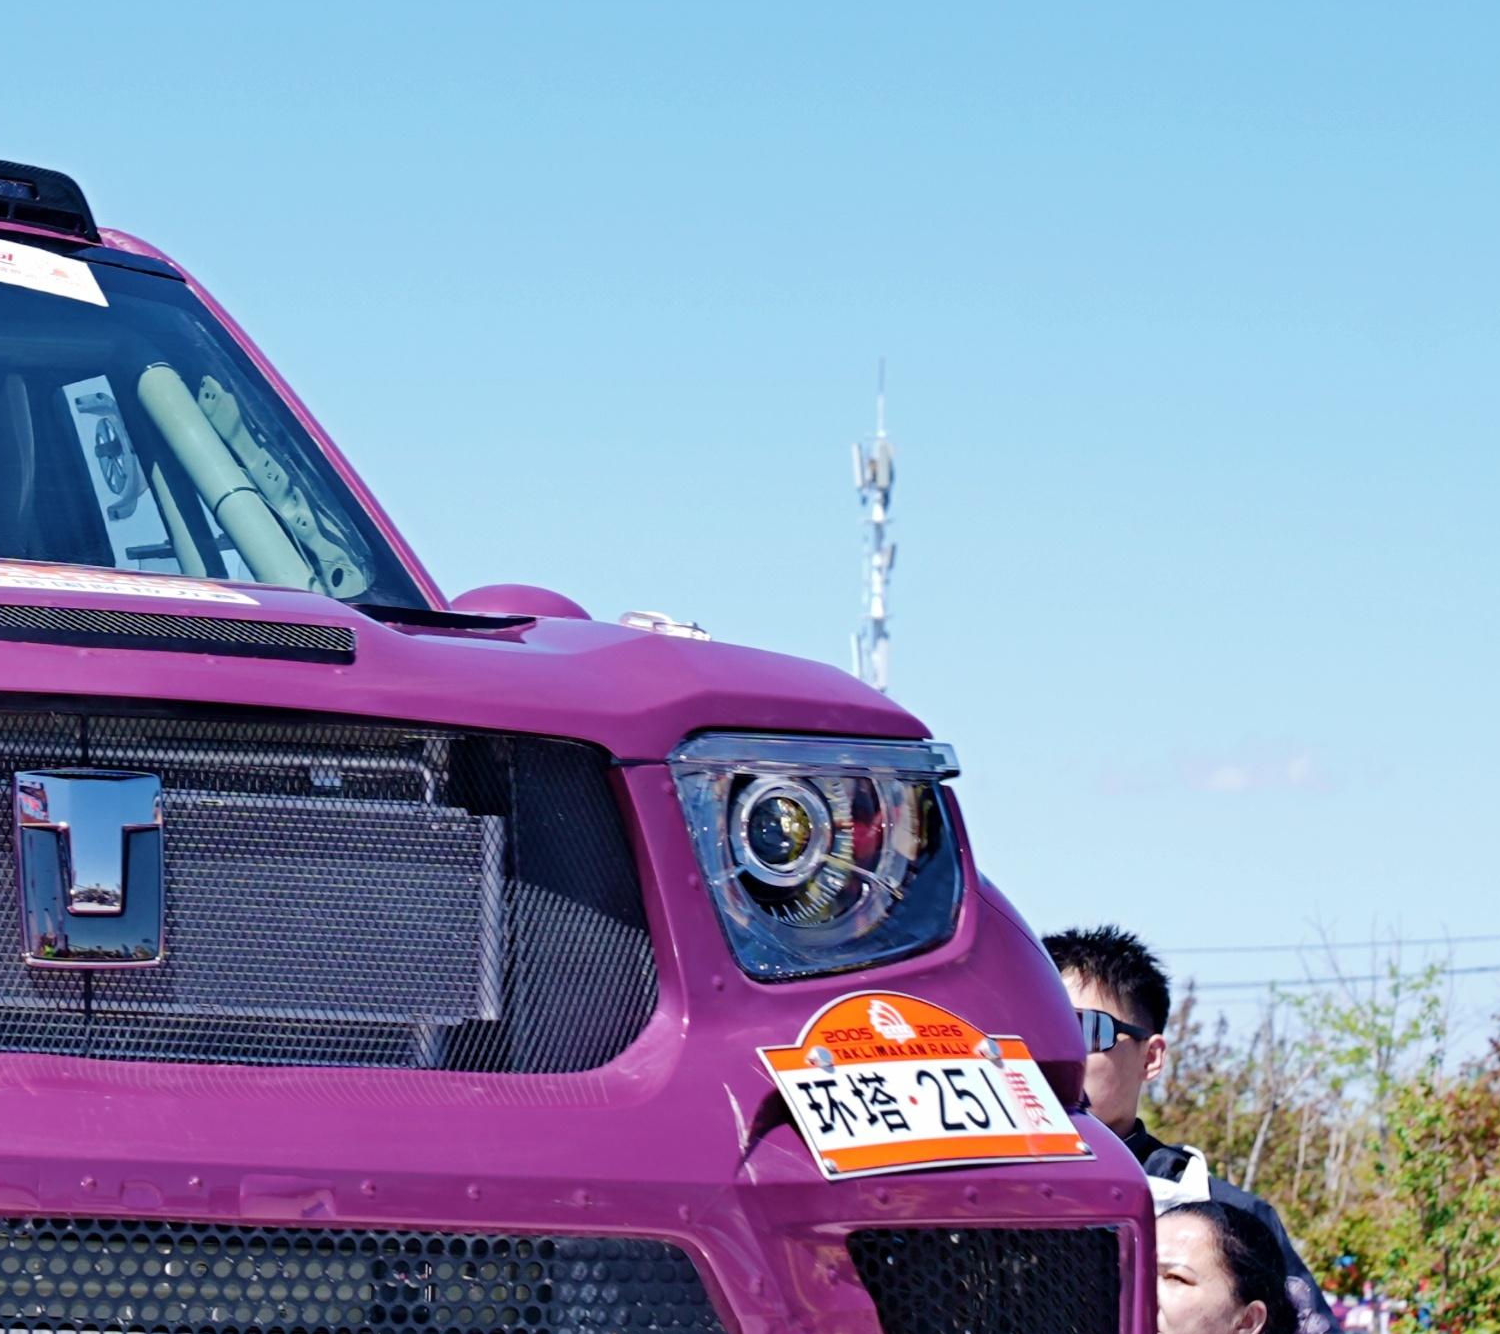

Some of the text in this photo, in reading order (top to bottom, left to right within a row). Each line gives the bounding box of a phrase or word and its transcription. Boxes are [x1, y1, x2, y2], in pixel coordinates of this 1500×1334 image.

[820, 1024, 963, 1043] 2005 2026
[833, 1041, 971, 1061] TAKLIMAKAN RALLY
